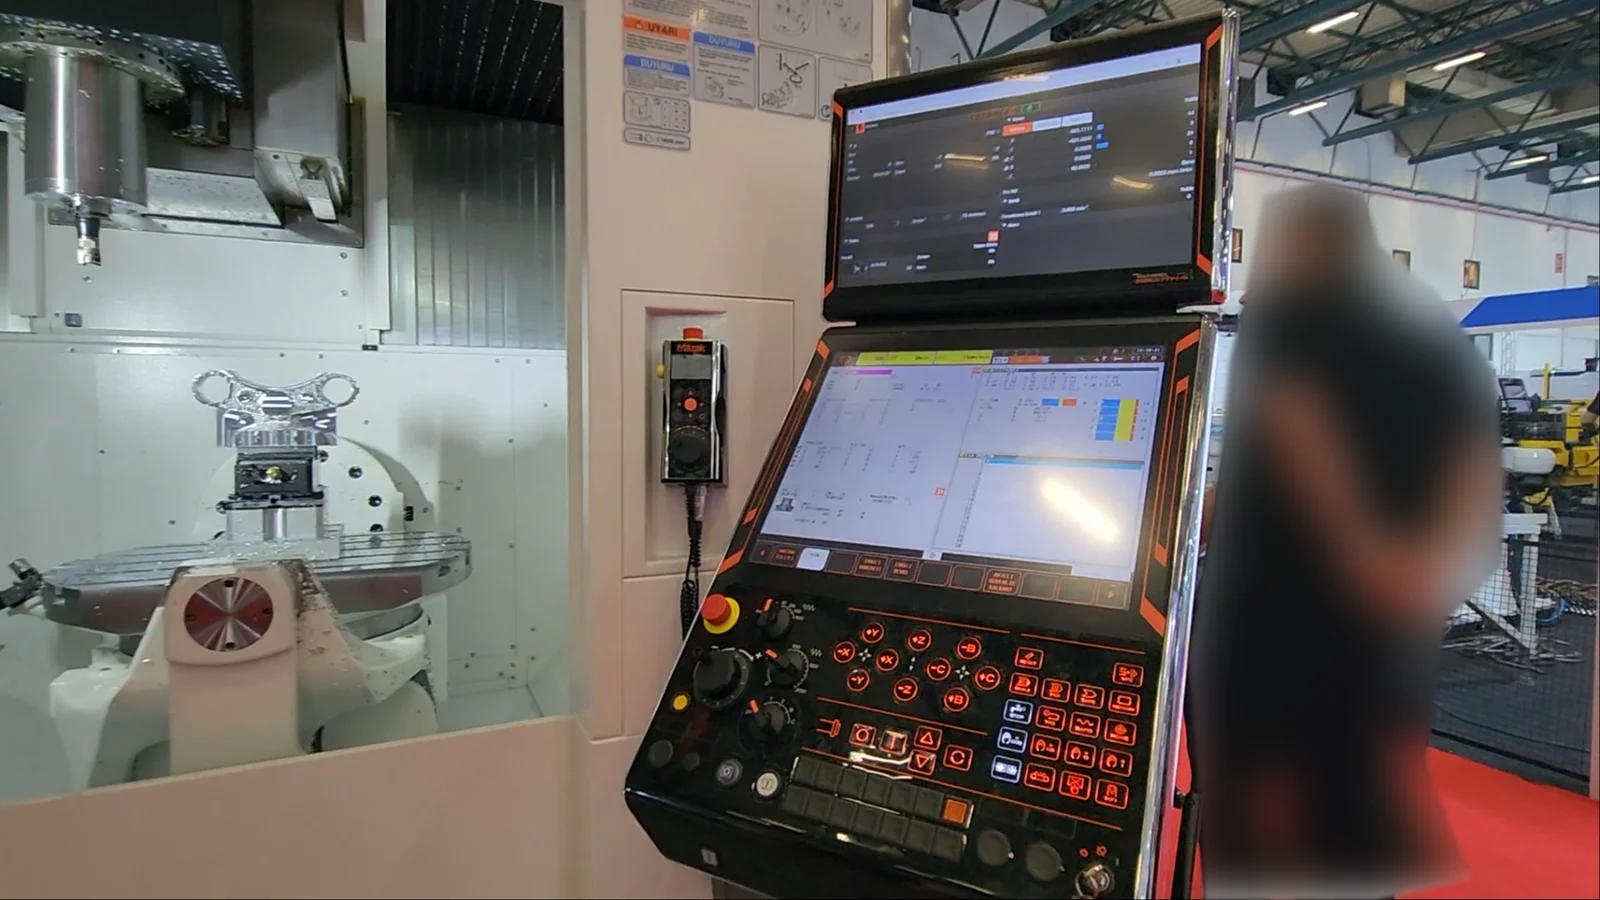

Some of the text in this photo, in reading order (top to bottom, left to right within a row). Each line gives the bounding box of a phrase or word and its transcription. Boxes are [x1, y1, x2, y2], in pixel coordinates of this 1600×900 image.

[648, 23, 678, 37] UYARI
[709, 35, 741, 49] DUYURU
[640, 58, 674, 71] DUYURU
[912, 636, 926, 645] +Z
